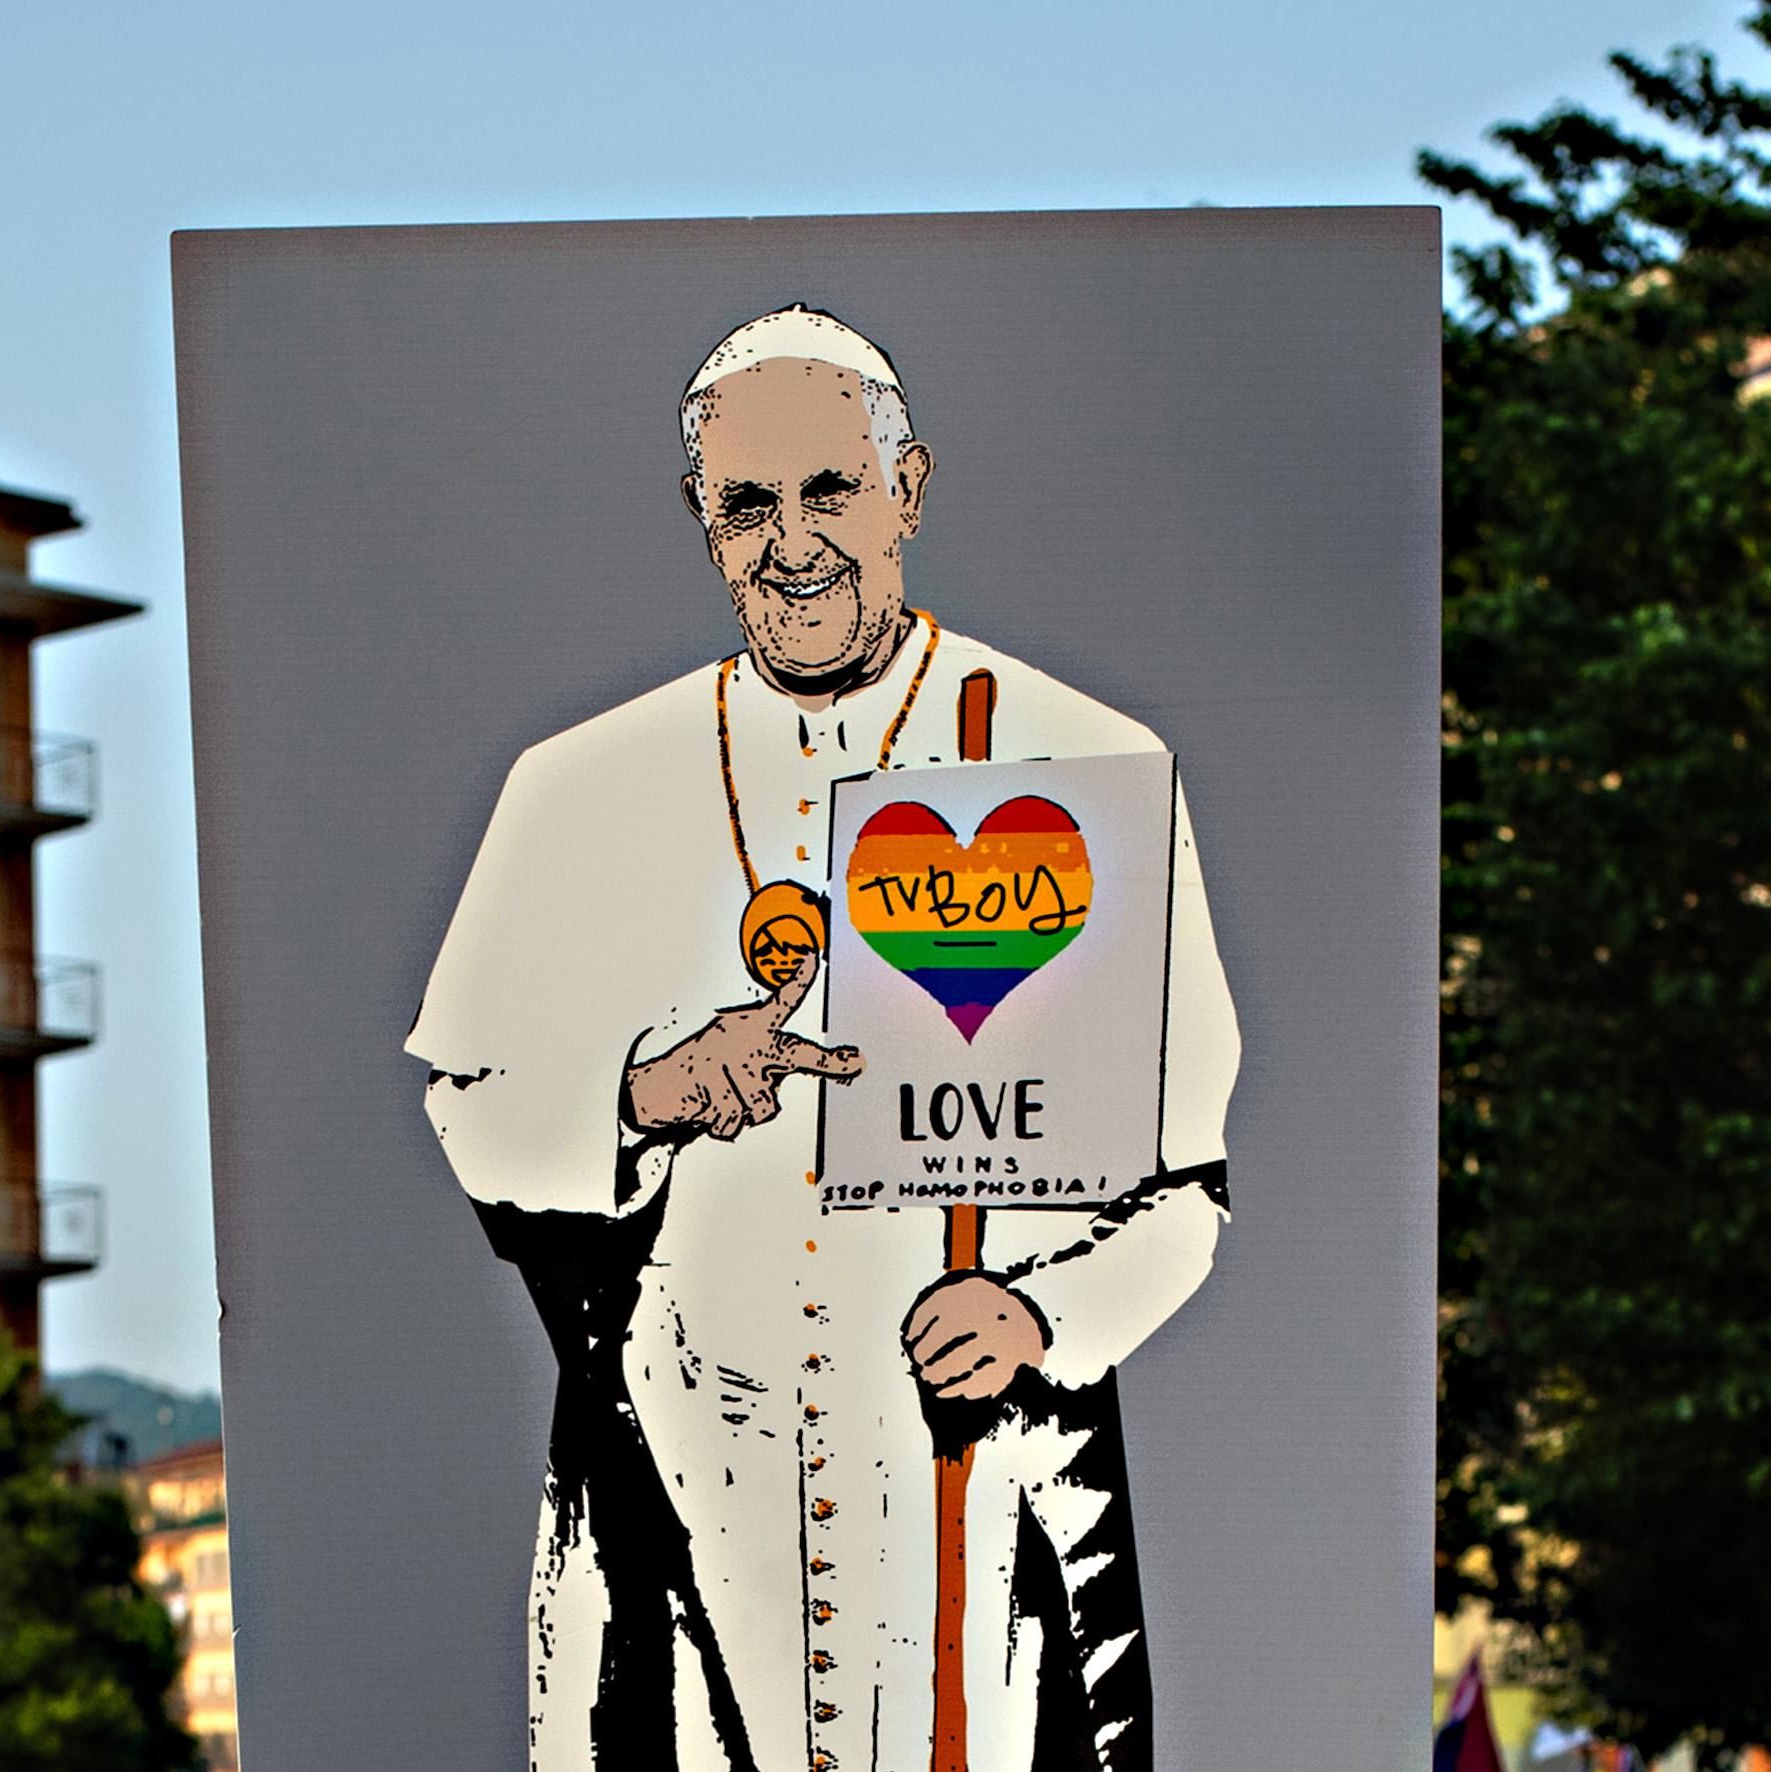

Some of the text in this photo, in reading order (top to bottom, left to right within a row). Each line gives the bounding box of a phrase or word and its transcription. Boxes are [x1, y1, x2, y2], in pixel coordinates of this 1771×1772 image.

[899, 1079, 1044, 1142] LOVE
[922, 1155, 1020, 1174] WINS
[821, 1180, 885, 1203] STOP
